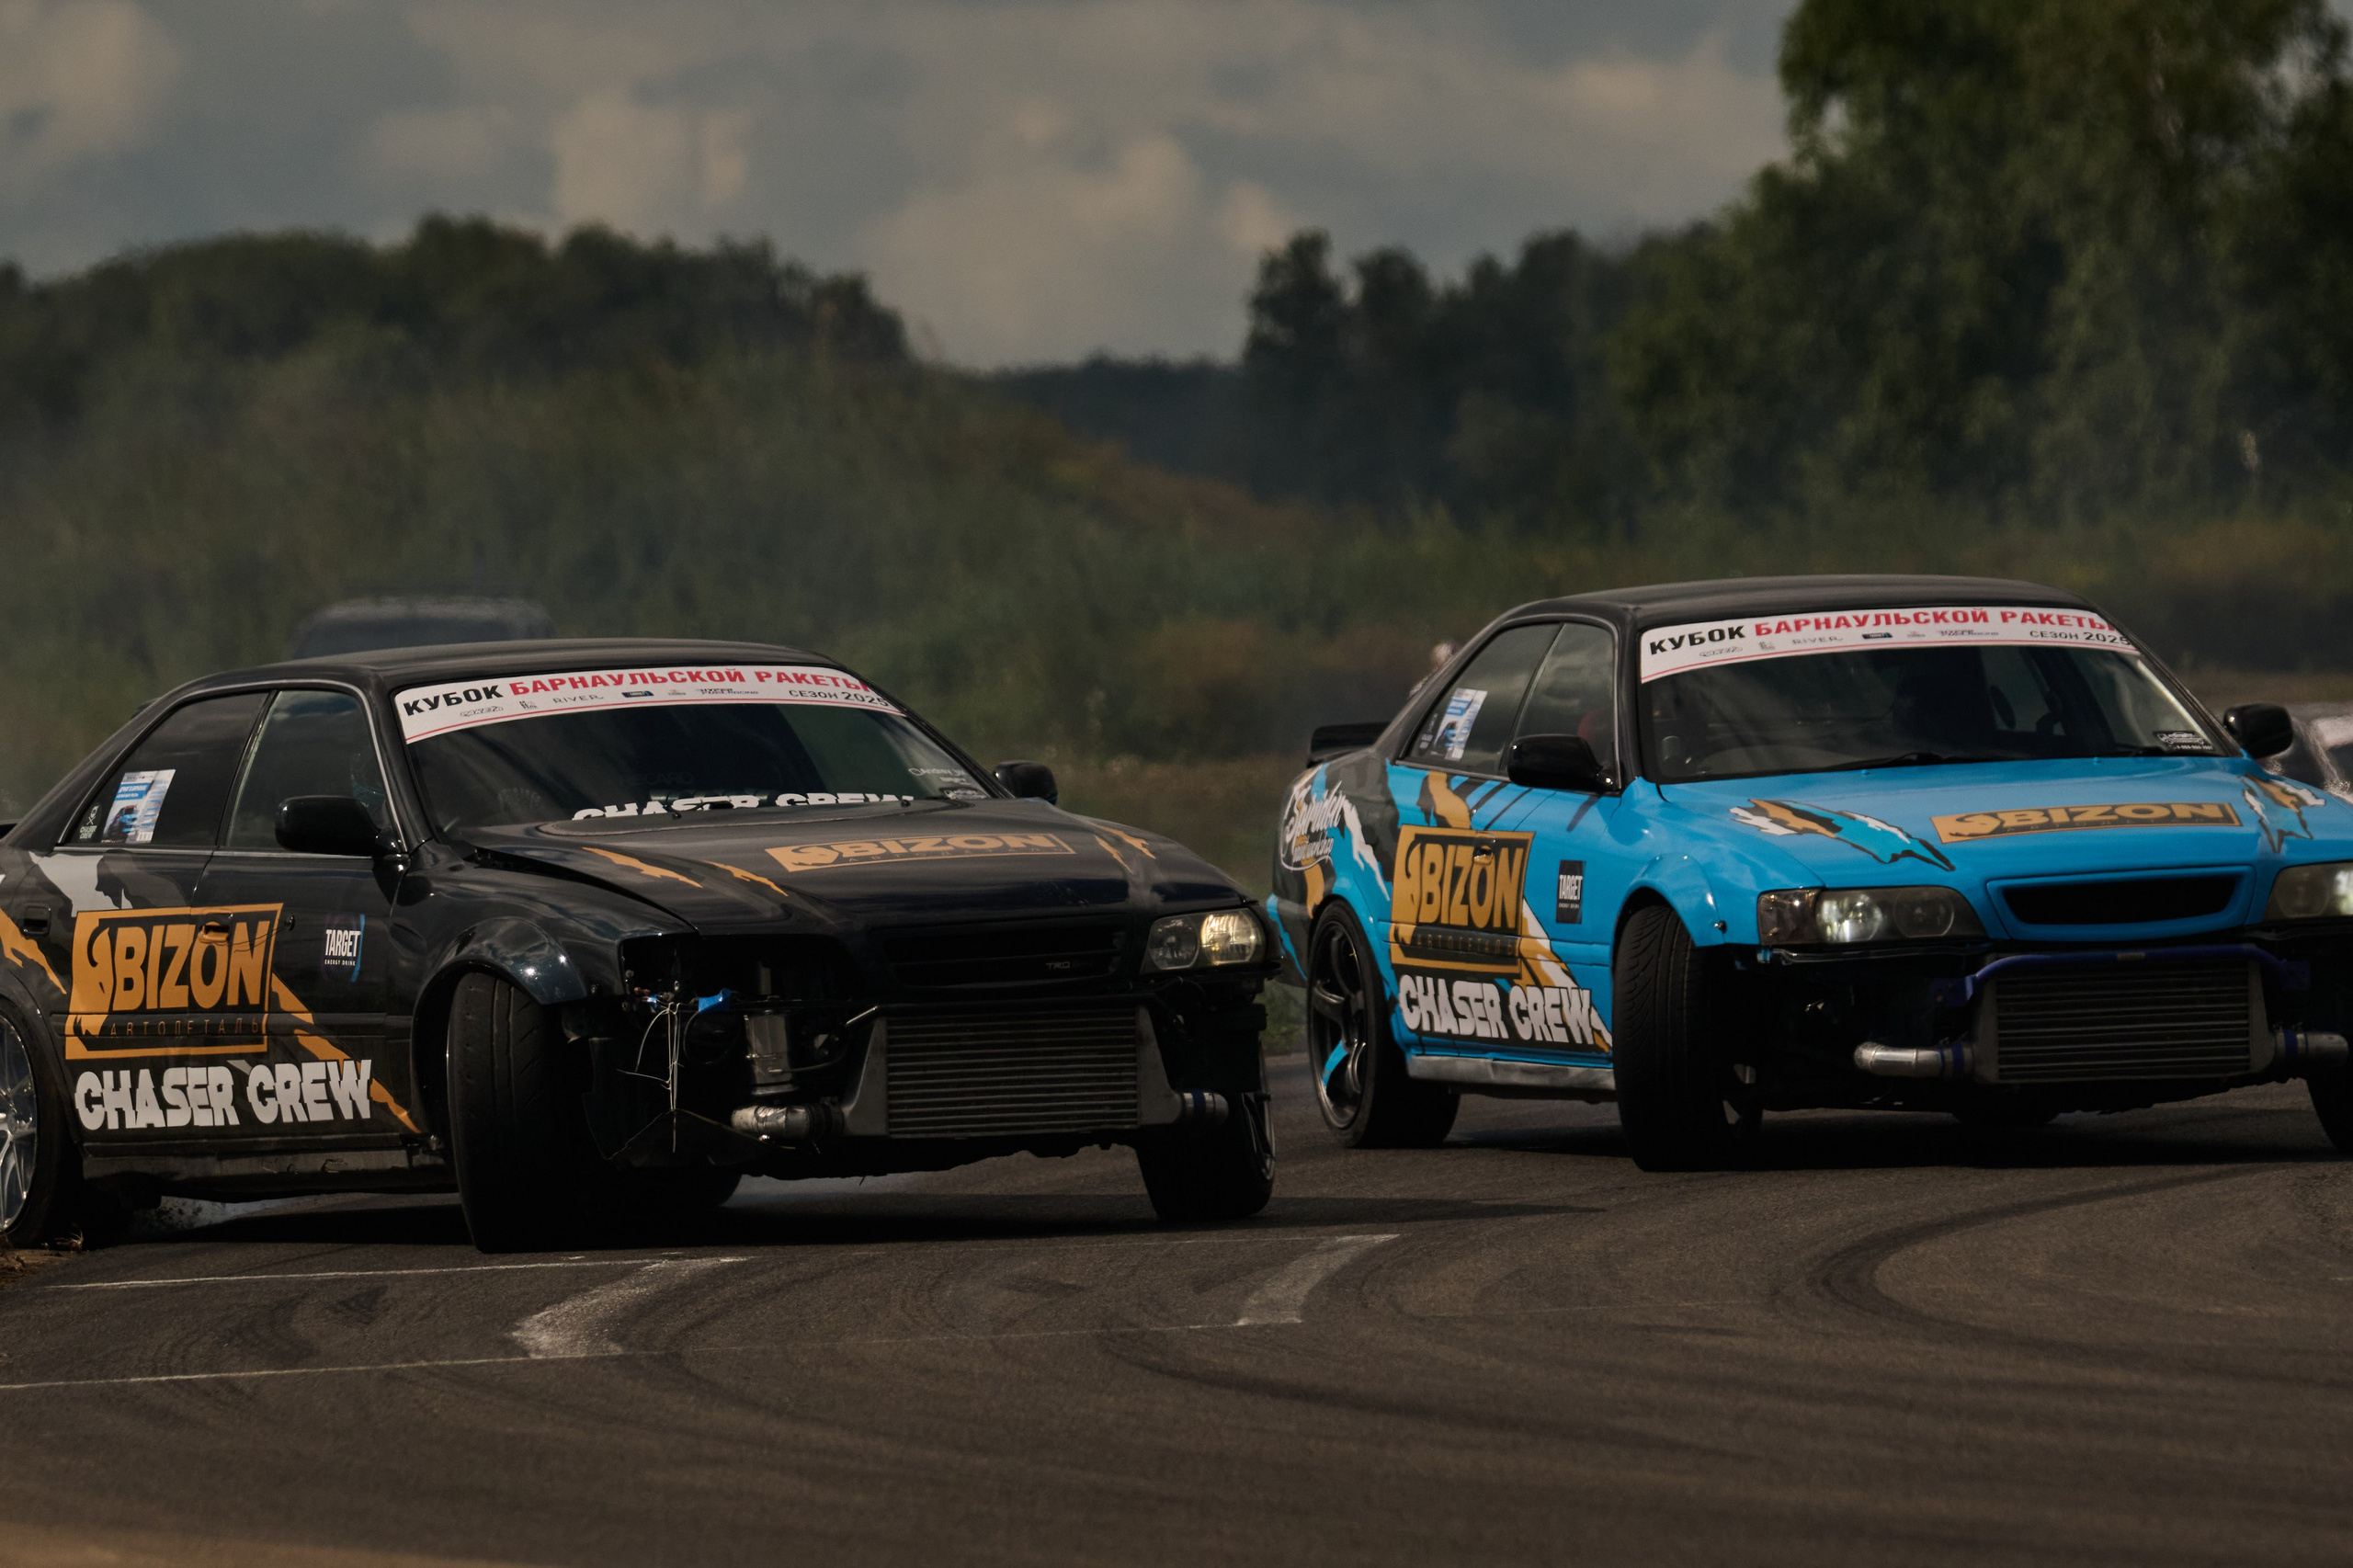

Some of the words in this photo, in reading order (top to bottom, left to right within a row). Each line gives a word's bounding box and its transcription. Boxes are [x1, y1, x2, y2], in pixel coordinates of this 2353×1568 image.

[1650, 625, 1745, 654] КУБОК
[1755, 608, 1989, 636] БАРНАУЛЬСКОЙ
[2000, 611, 2116, 631] РАКЕТЫ
[2029, 631, 2079, 641] СЕЗОН
[2084, 631, 2131, 645] 2025
[403, 685, 504, 716] КУБОК
[509, 667, 746, 696] БАРНАУЛЬСКОЙ
[754, 671, 870, 693] РАКЕТЫ
[552, 695, 603, 705] RIVER
[789, 689, 838, 699] СЕЗОН
[844, 691, 890, 708] 2025
[1997, 803, 2225, 827] BIZON
[832, 835, 1051, 857] BIZON
[1418, 842, 1524, 929] BIZON
[1559, 874, 1584, 900] TARGET
[324, 928, 361, 957] TARGET
[113, 920, 271, 1011] BIZON
[1398, 974, 1509, 1039] CHASER
[1508, 985, 1596, 1045] CREW
[74, 1065, 240, 1131] CHASER
[245, 1059, 372, 1125] CREW
